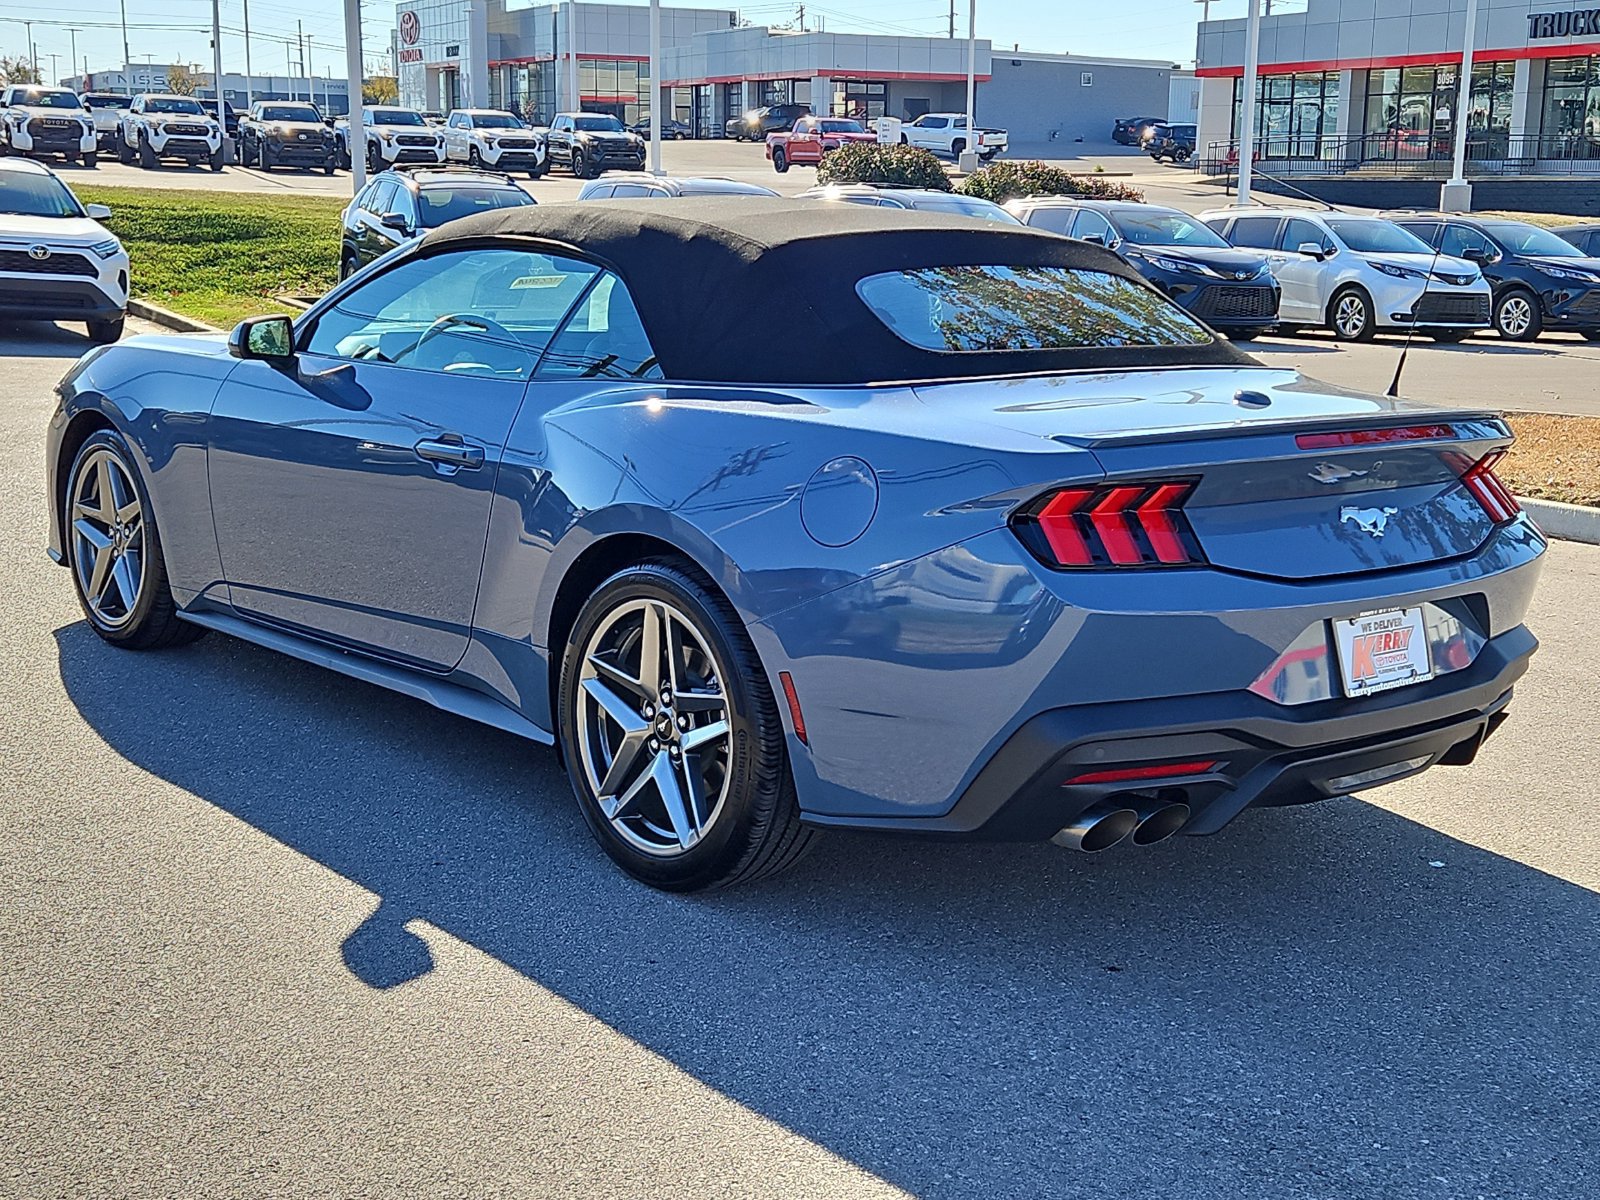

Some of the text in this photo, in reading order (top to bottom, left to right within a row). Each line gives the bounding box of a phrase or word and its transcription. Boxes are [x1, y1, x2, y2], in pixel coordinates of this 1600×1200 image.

[1437, 73, 1455, 84] 8095
[1361, 617, 1403, 633] WE DELIVER
[1352, 627, 1413, 681] KERRY
[1385, 653, 1408, 664] TOYOTA
[734, 728, 747, 799] Continental
